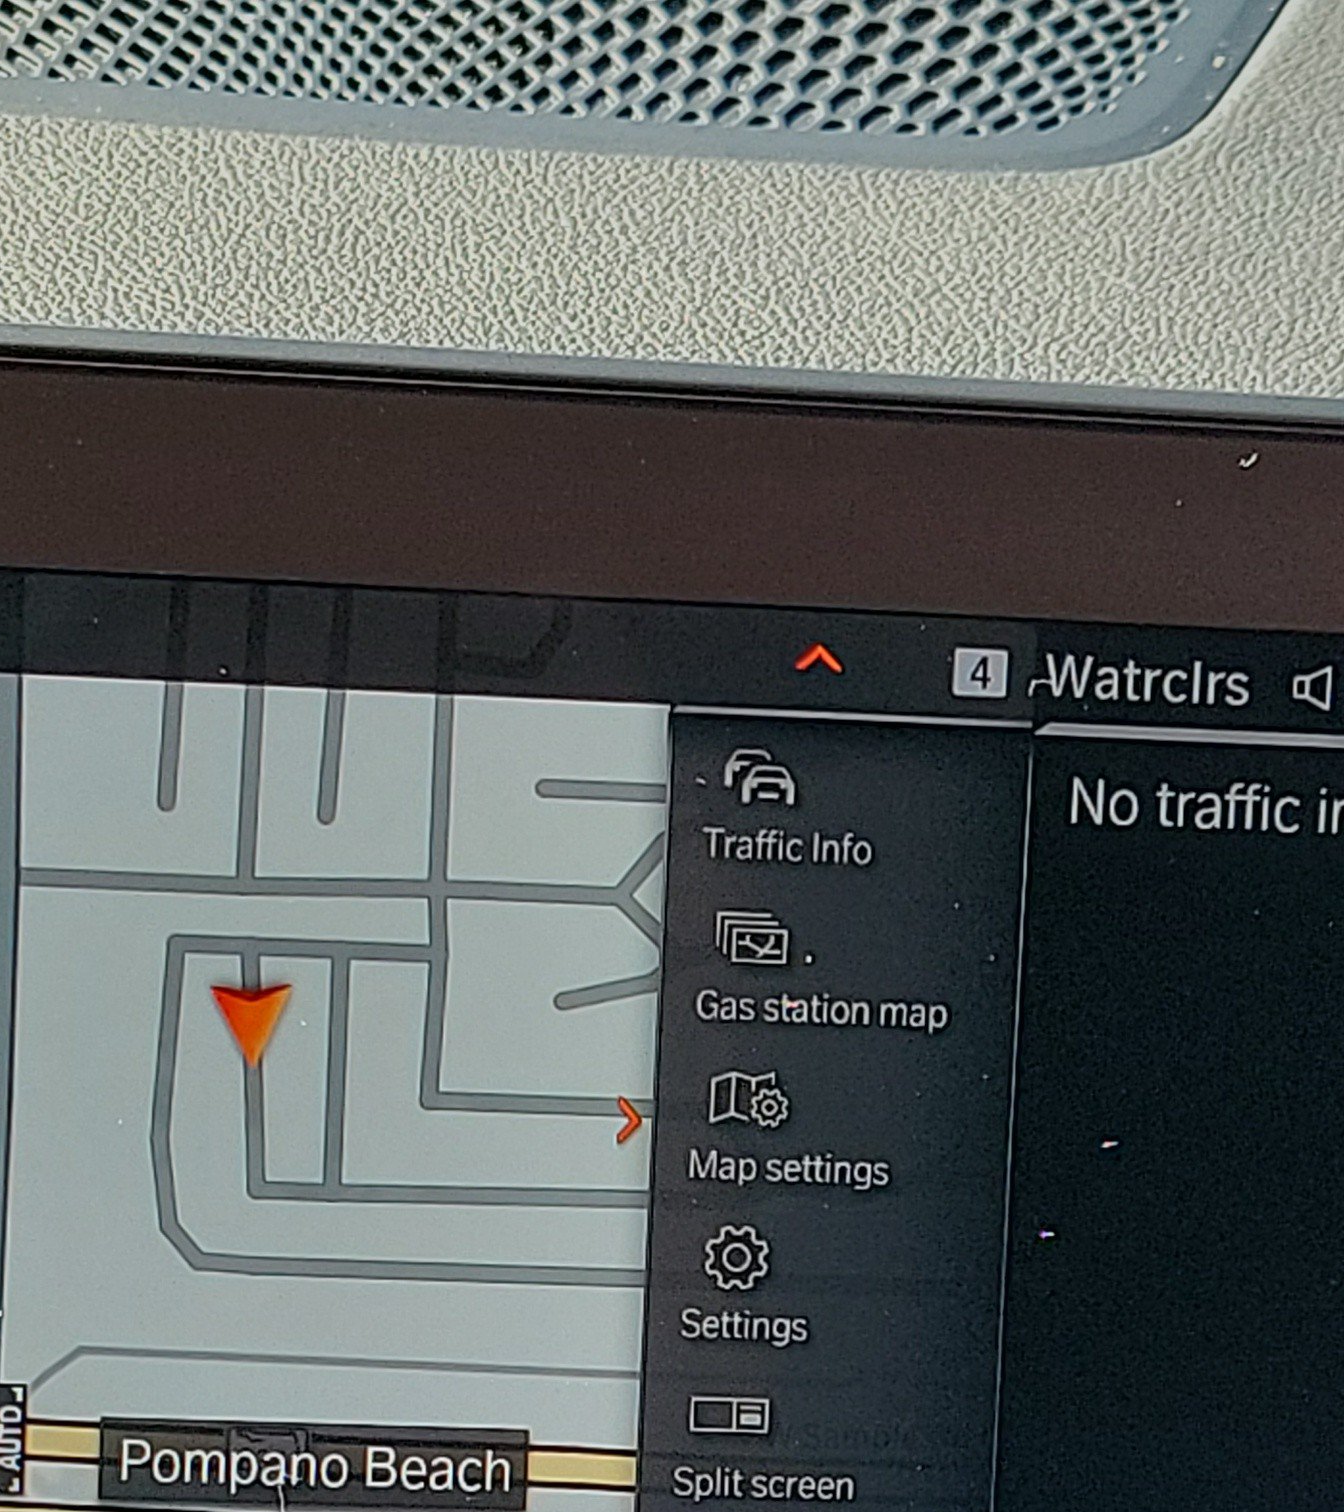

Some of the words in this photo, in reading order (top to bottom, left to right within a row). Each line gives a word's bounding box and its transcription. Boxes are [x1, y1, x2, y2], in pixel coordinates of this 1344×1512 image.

[969, 655, 993, 690] 4
[1046, 653, 1249, 705] Watrclrs
[1069, 776, 1138, 825] No
[1157, 782, 1300, 833] traffic
[703, 825, 802, 862] Traffic
[812, 832, 873, 866] Info
[695, 989, 755, 1022] Gas
[762, 992, 870, 1026] station
[879, 1000, 949, 1033] map
[688, 1149, 757, 1184] Map
[765, 1154, 890, 1190] settings
[680, 1308, 809, 1347] Settings
[119, 1439, 349, 1494] Pompano
[365, 1445, 511, 1493] Beach
[672, 1466, 744, 1502] Split
[750, 1472, 855, 1500] screen
